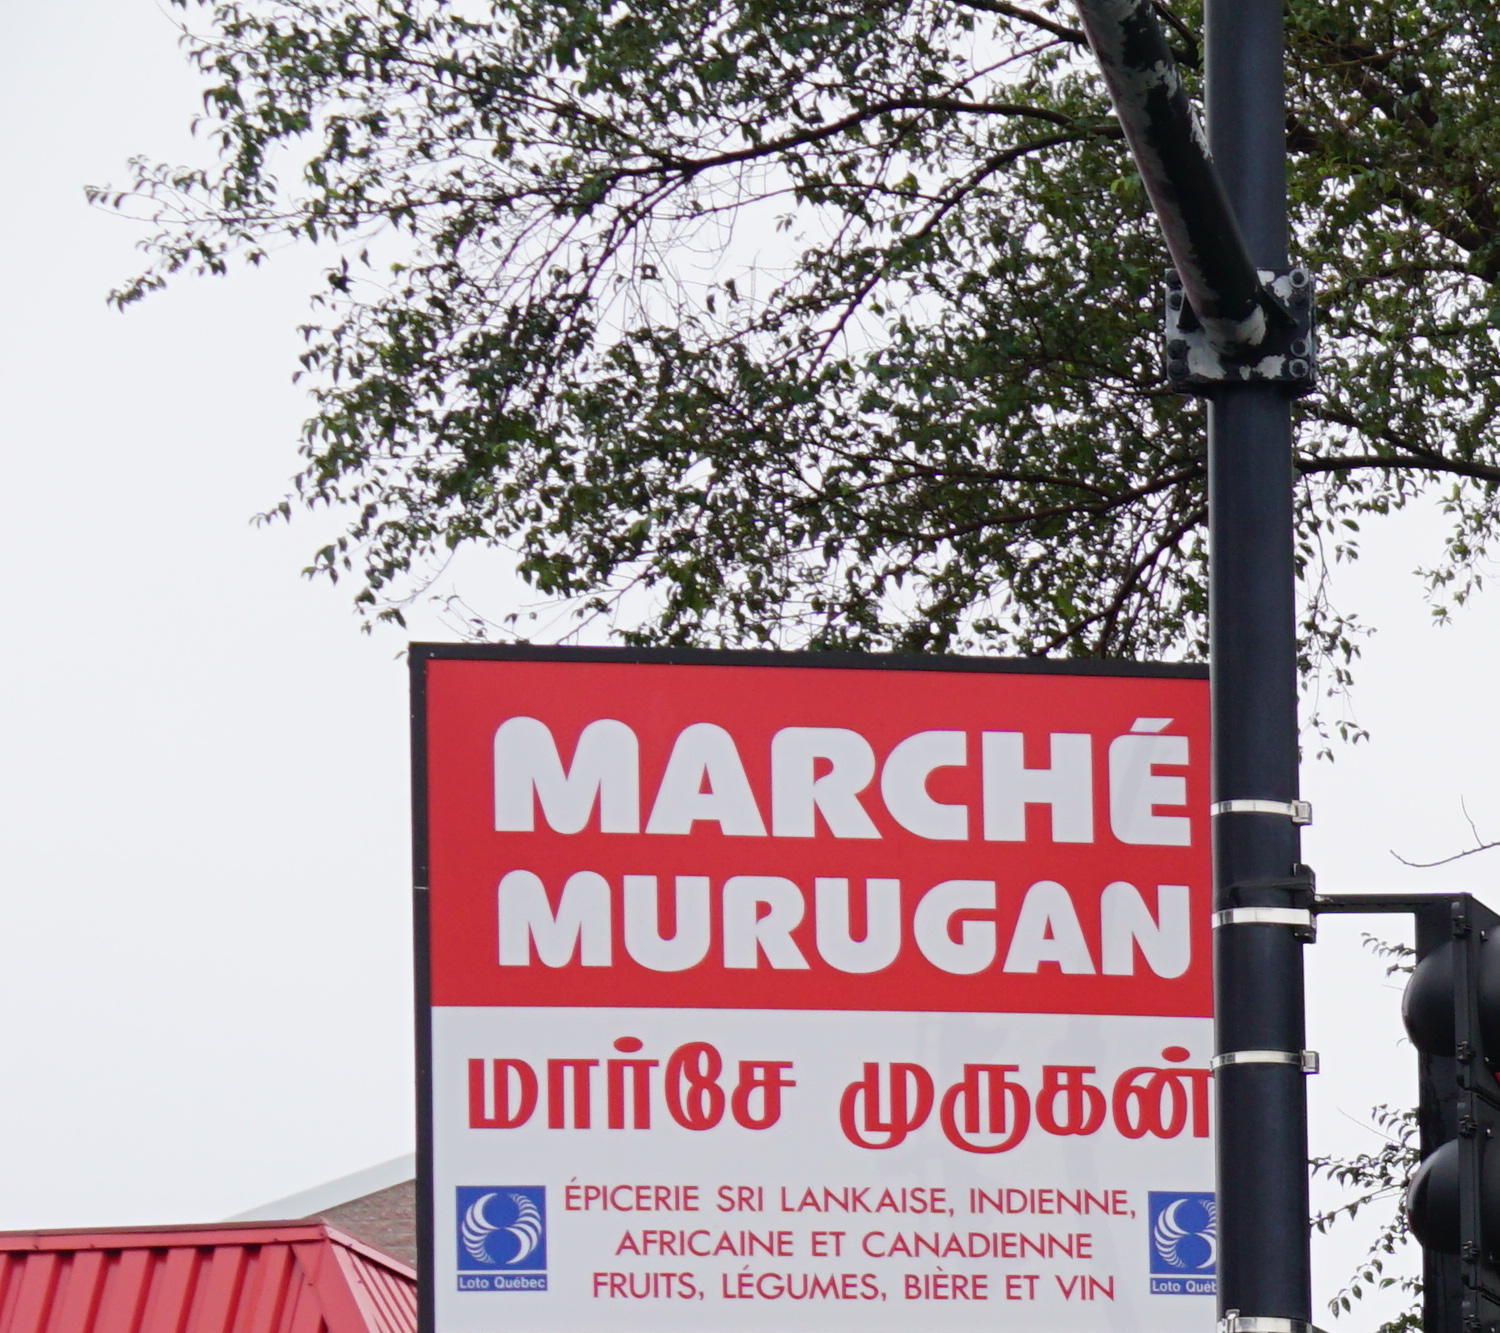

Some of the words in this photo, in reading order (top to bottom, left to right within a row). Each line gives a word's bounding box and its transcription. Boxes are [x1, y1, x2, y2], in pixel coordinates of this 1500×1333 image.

[494, 715, 1192, 846] MARCHÉ
[497, 869, 1192, 979] MURUGAN
[467, 1036, 796, 1130] மார்சே
[839, 1045, 1213, 1154] முருகன்
[564, 1176, 700, 1211] ÉPICERIE
[716, 1184, 763, 1212] SRI
[781, 1186, 955, 1217] LANKAISE,
[970, 1187, 1137, 1219] INDIENNE,
[615, 1229, 794, 1257] AFRICAINE
[811, 1231, 846, 1257] ET
[861, 1231, 1093, 1259] CANADIENNE
[459, 1276, 490, 1289] Loto
[494, 1276, 546, 1289] Québec
[593, 1271, 705, 1300] FRUITS,
[722, 1264, 887, 1301] LÉGUMES,
[904, 1265, 988, 1300] BIÈRE
[1005, 1274, 1040, 1300] ET
[1054, 1275, 1115, 1302] VIN
[1152, 1280, 1181, 1292] Loto
[1185, 1280, 1217, 1292] Québ
